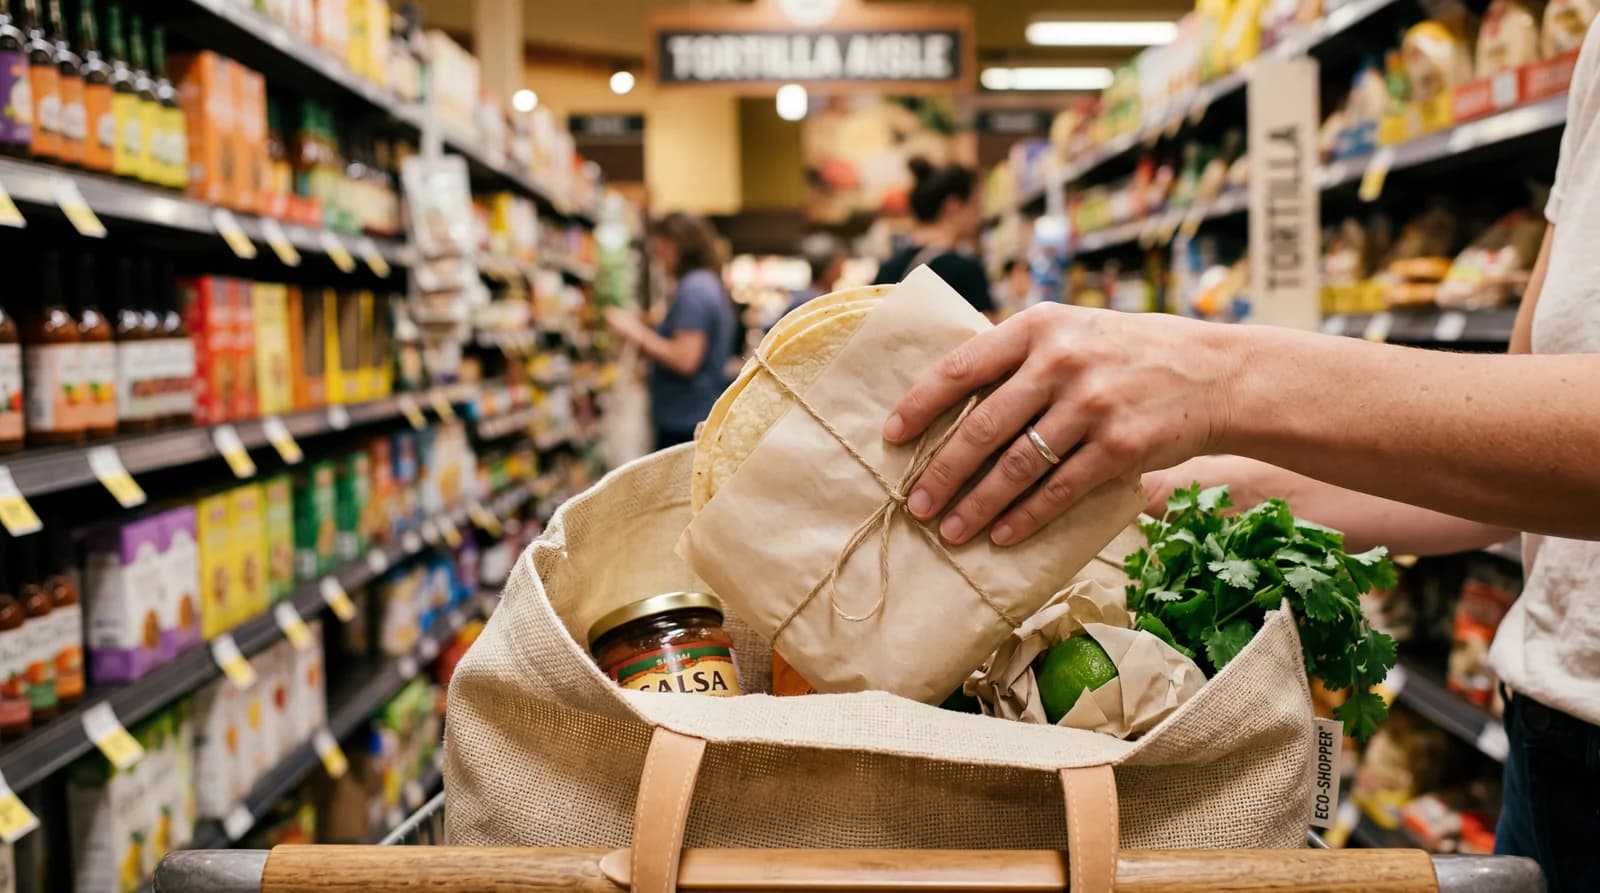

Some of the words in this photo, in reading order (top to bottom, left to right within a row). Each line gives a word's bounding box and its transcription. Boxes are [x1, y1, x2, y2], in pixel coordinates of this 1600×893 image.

[667, 33, 843, 80] TORTILLA
[845, 33, 952, 80] AISLE
[1265, 125, 1303, 293] TORTILLA
